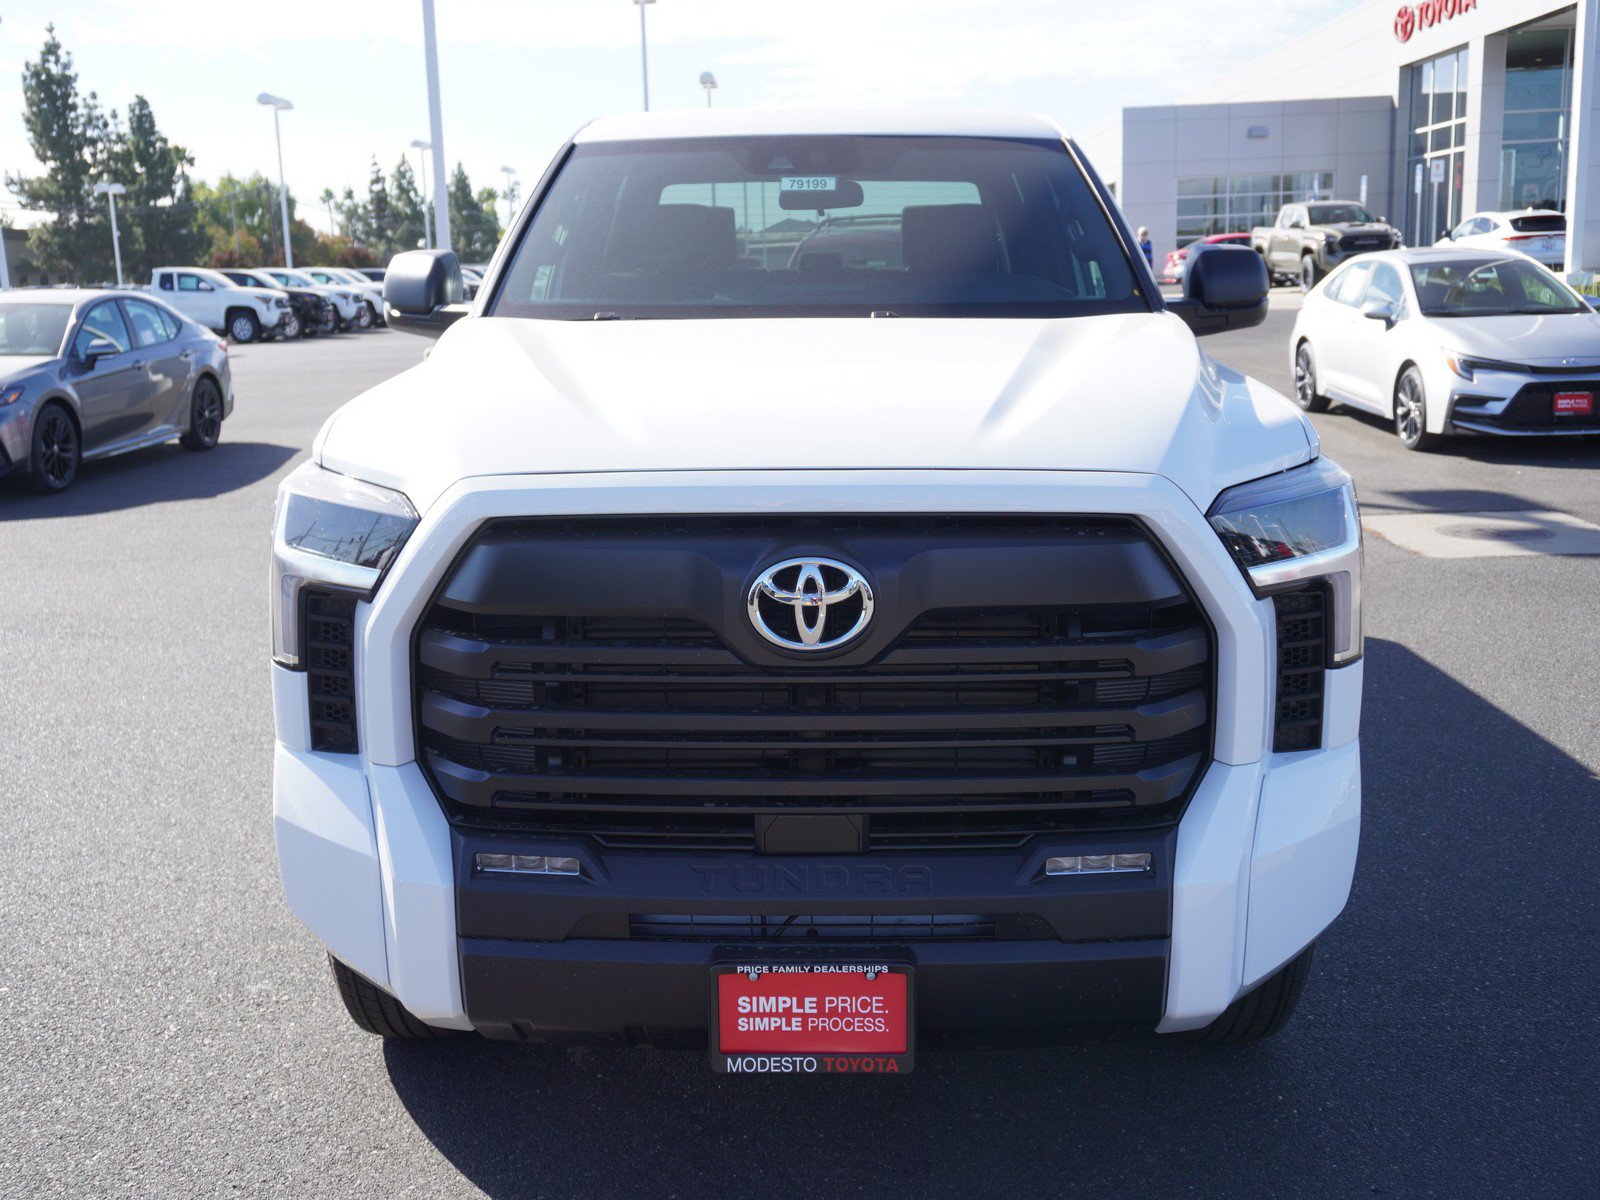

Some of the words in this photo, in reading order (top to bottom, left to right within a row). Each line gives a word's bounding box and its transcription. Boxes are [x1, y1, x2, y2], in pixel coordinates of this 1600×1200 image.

[789, 179, 827, 189] 79199
[690, 864, 934, 892] TUNDRA
[737, 966, 769, 974] PRICE
[738, 996, 818, 1013] SIMPLE
[825, 997, 888, 1014] PRICE.
[738, 1018, 802, 1031] SIMPLE
[808, 1018, 889, 1032] PROCESS.
[727, 1058, 817, 1072] MODESTO
[824, 1058, 899, 1072] TOYOTA
